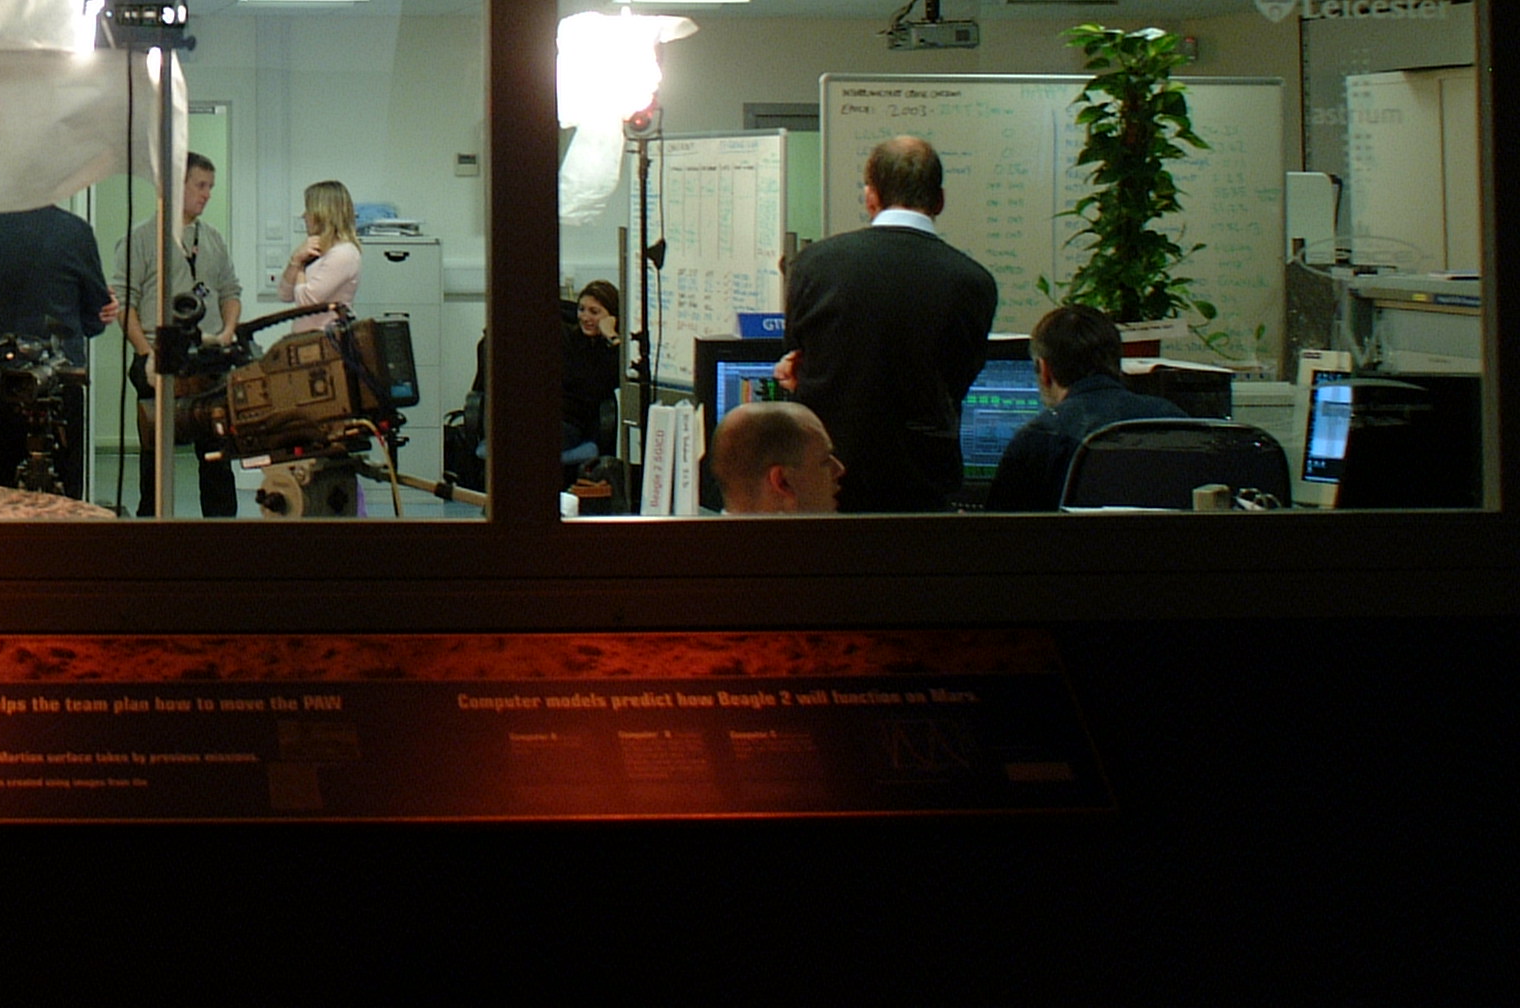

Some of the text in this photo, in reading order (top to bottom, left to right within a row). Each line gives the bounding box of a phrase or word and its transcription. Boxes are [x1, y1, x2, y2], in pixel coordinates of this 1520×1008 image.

[32, 695, 60, 710] the
[65, 695, 108, 710] team
[113, 695, 149, 714] plan
[155, 695, 191, 710] how
[197, 695, 214, 710] to
[220, 698, 264, 710] move
[270, 695, 297, 710] the
[303, 695, 341, 710] PAW
[457, 693, 541, 712] Computer
[545, 692, 606, 708] models
[610, 692, 672, 710] predict
[676, 691, 713, 706] how
[717, 691, 775, 709] Beagle
[780, 690, 791, 705] 2
[796, 690, 828, 705] will
[832, 690, 901, 704] function
[905, 693, 926, 704] on
